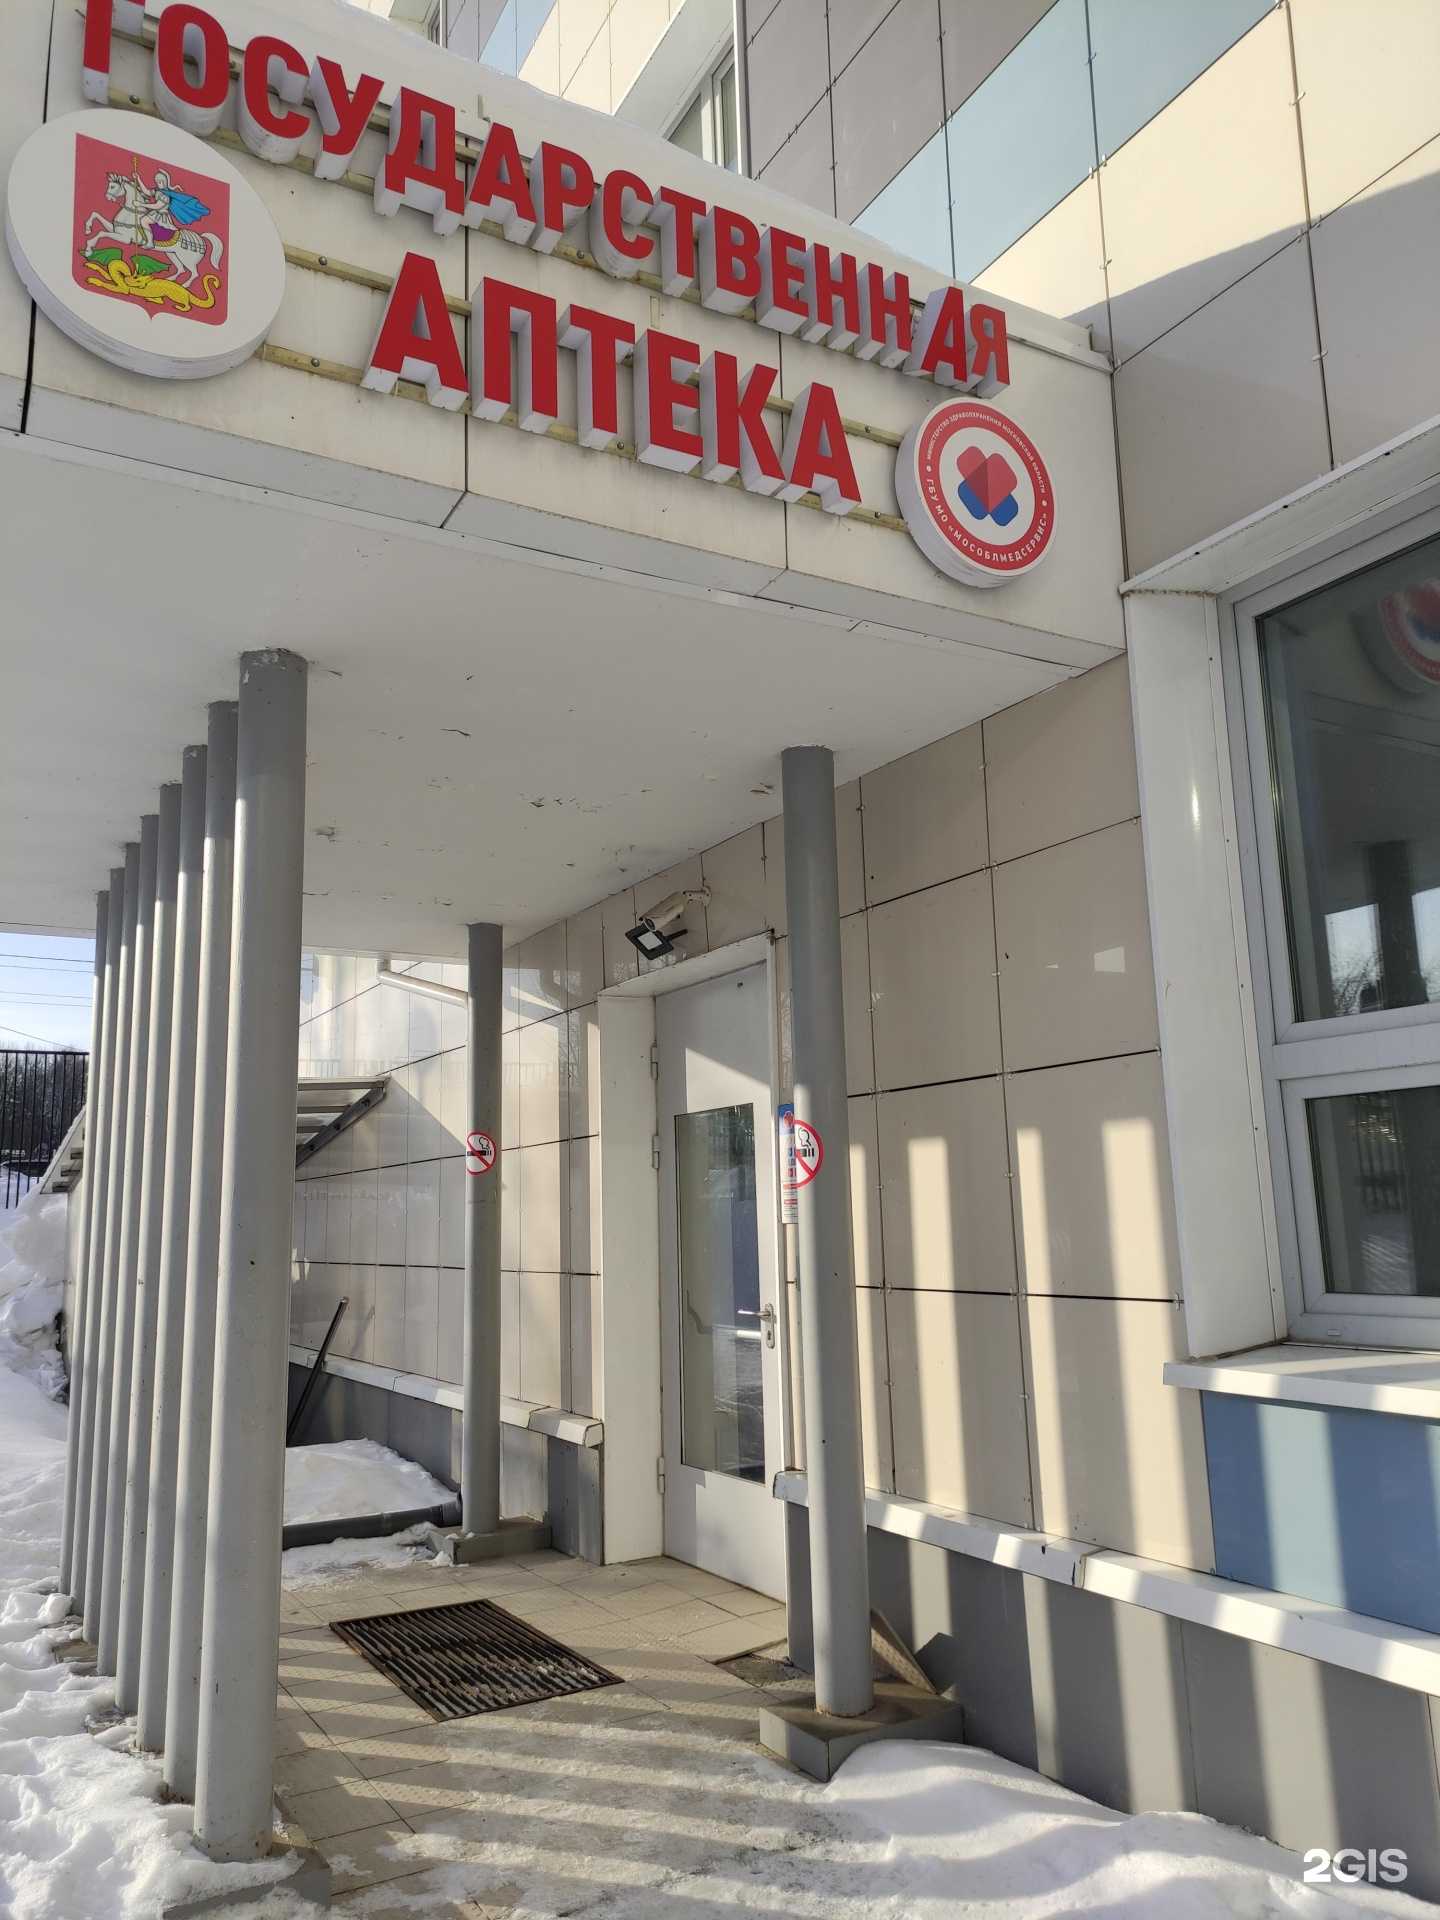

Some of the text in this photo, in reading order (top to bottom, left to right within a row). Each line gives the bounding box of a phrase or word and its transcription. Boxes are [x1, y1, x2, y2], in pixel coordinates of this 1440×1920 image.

[368, 250, 862, 506] АПТЕКА
[926, 479, 1047, 563] ГБУ МО «МОСОБЛМЕДСЕРВИС»
